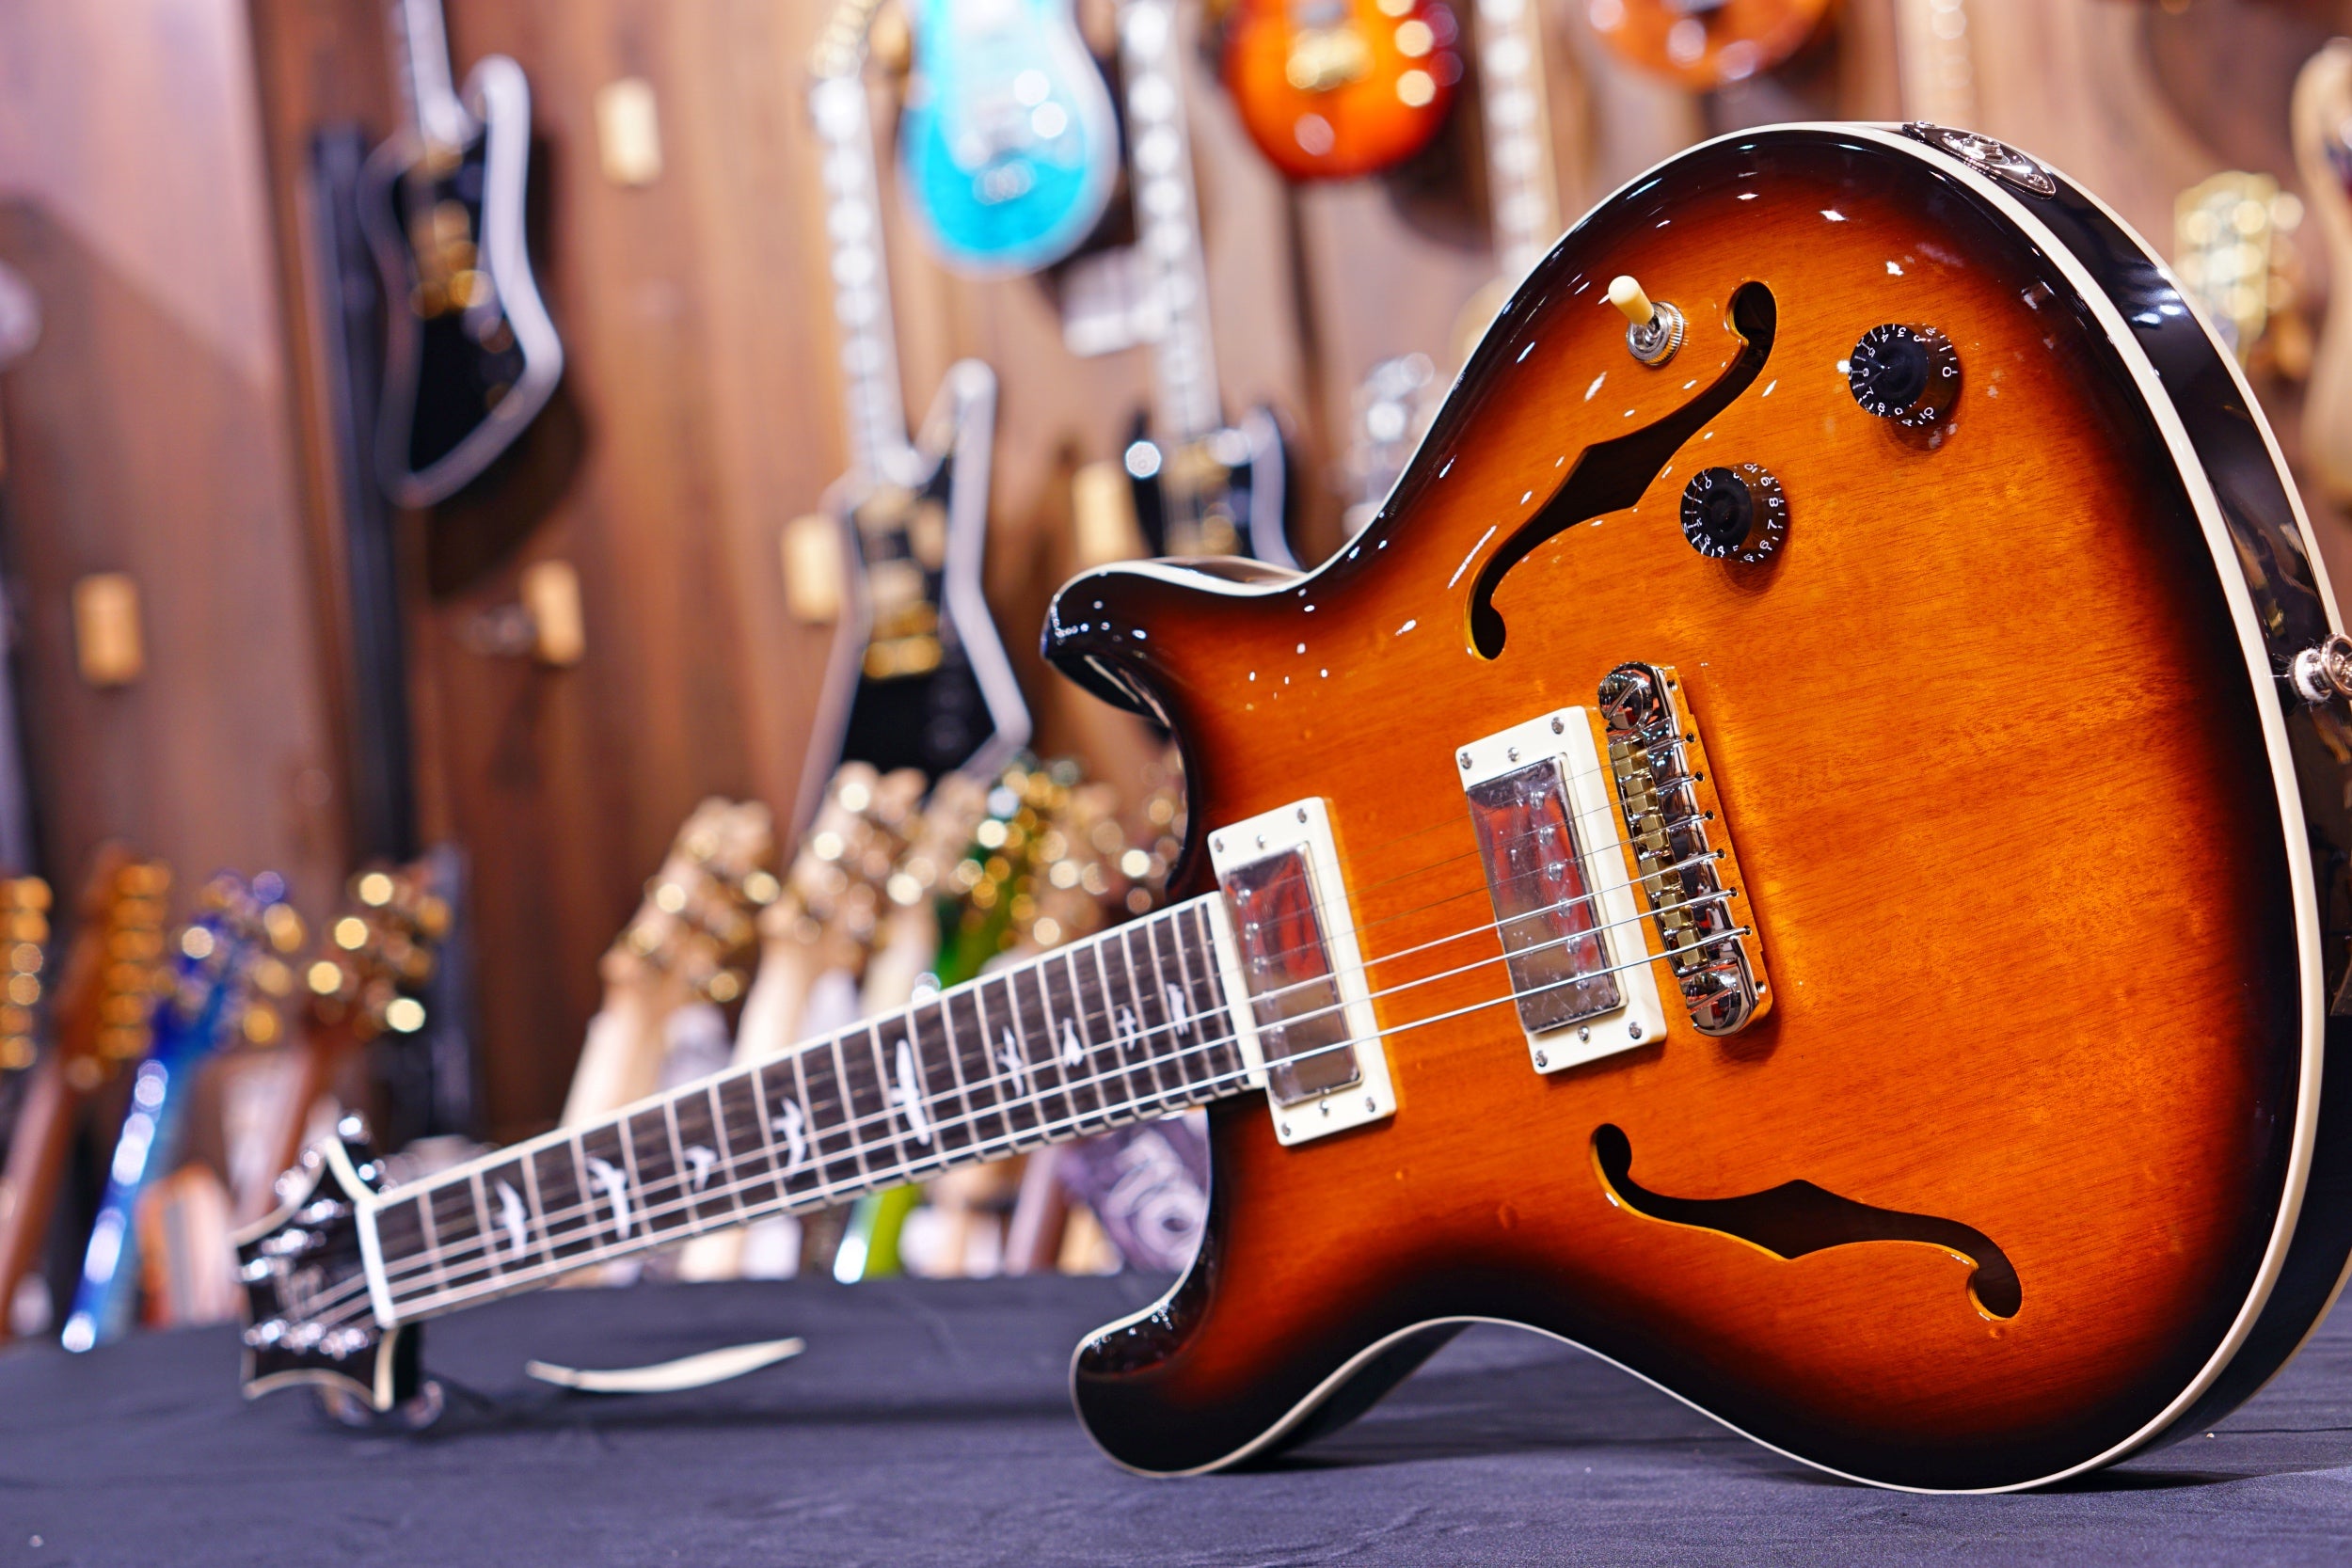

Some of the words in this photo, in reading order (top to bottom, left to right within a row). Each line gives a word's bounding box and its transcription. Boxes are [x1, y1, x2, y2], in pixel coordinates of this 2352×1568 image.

[1898, 327, 1906, 338] 3
[1881, 333, 1889, 343] 4
[1943, 367, 1952, 377] 0
[1878, 403, 1885, 413] 8
[1769, 498, 1779, 507] 8
[1768, 519, 1777, 530] 7
